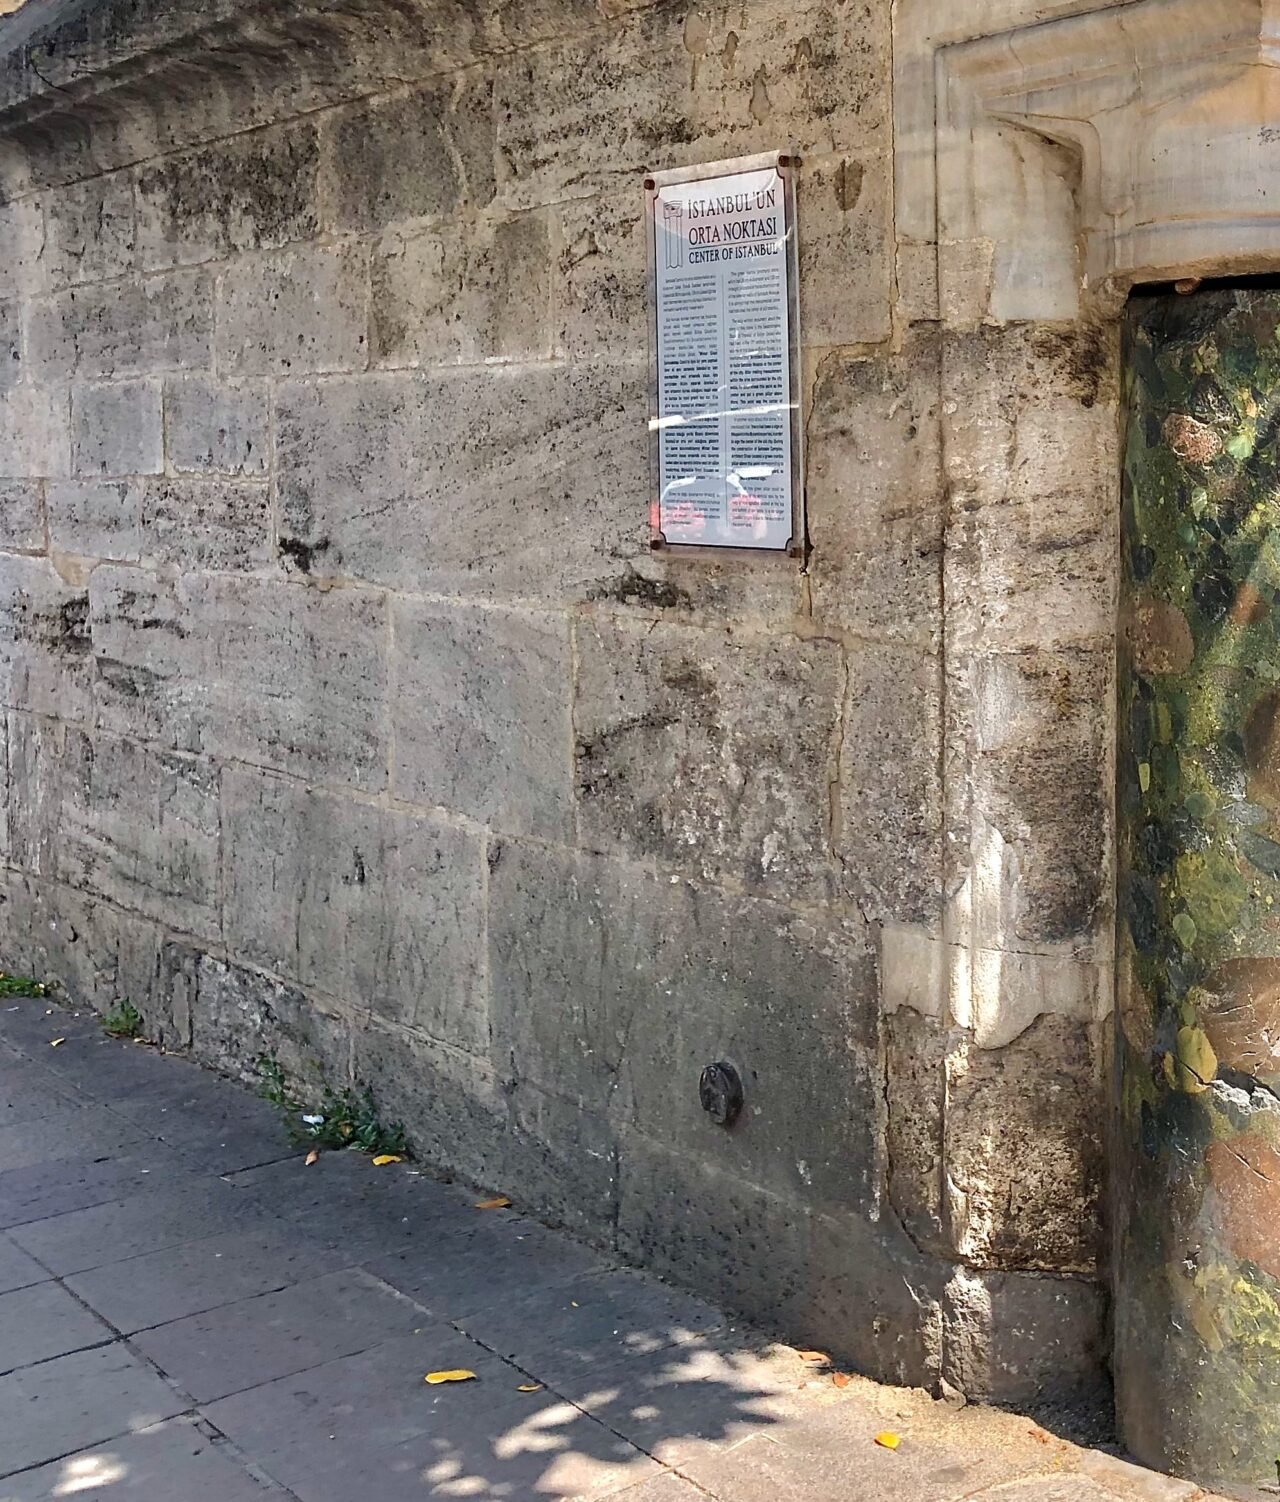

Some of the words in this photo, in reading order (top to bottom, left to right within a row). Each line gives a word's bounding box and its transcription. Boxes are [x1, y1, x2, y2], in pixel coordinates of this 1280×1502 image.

[688, 226, 721, 246] ORTA
[723, 217, 777, 240] NOKTASI
[688, 249, 720, 264] CENTER
[721, 248, 733, 261] OF
